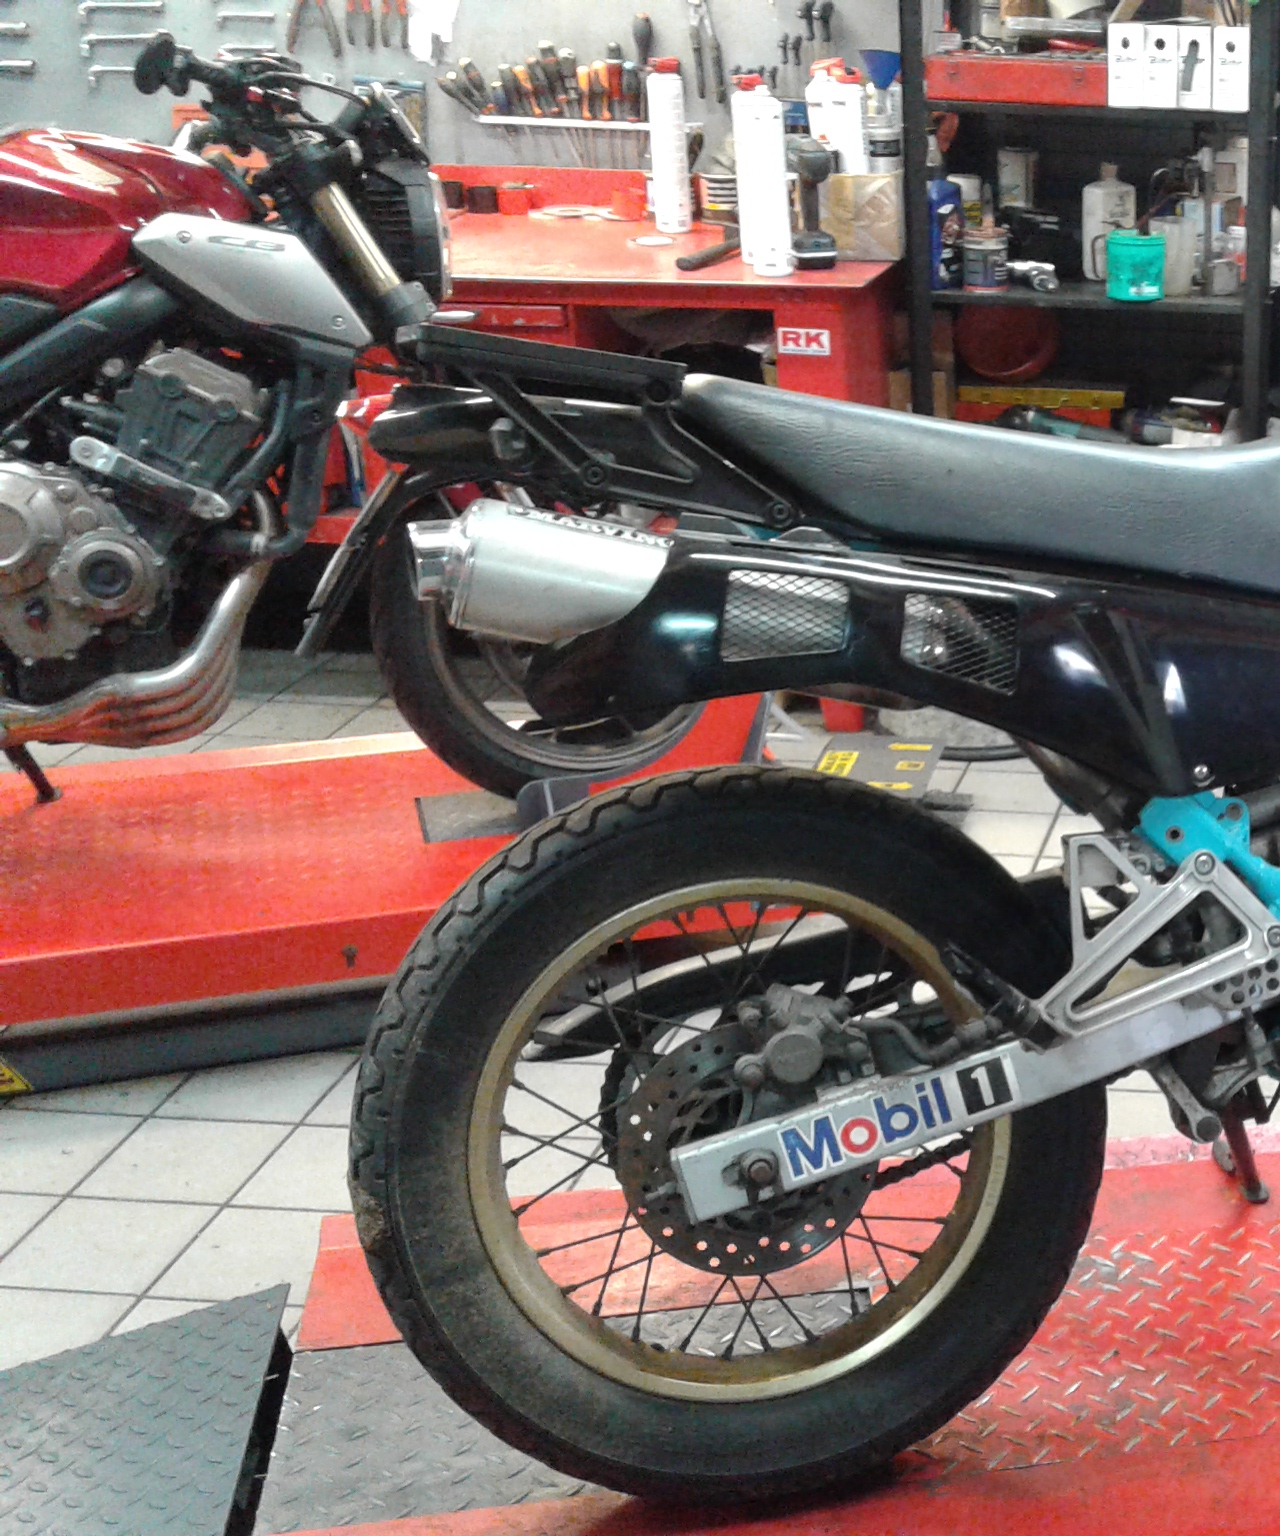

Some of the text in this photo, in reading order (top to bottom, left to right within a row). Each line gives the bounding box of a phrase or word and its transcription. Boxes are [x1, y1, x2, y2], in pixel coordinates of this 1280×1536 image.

[781, 330, 825, 349] RK
[781, 1066, 995, 1168] Mobil 1
